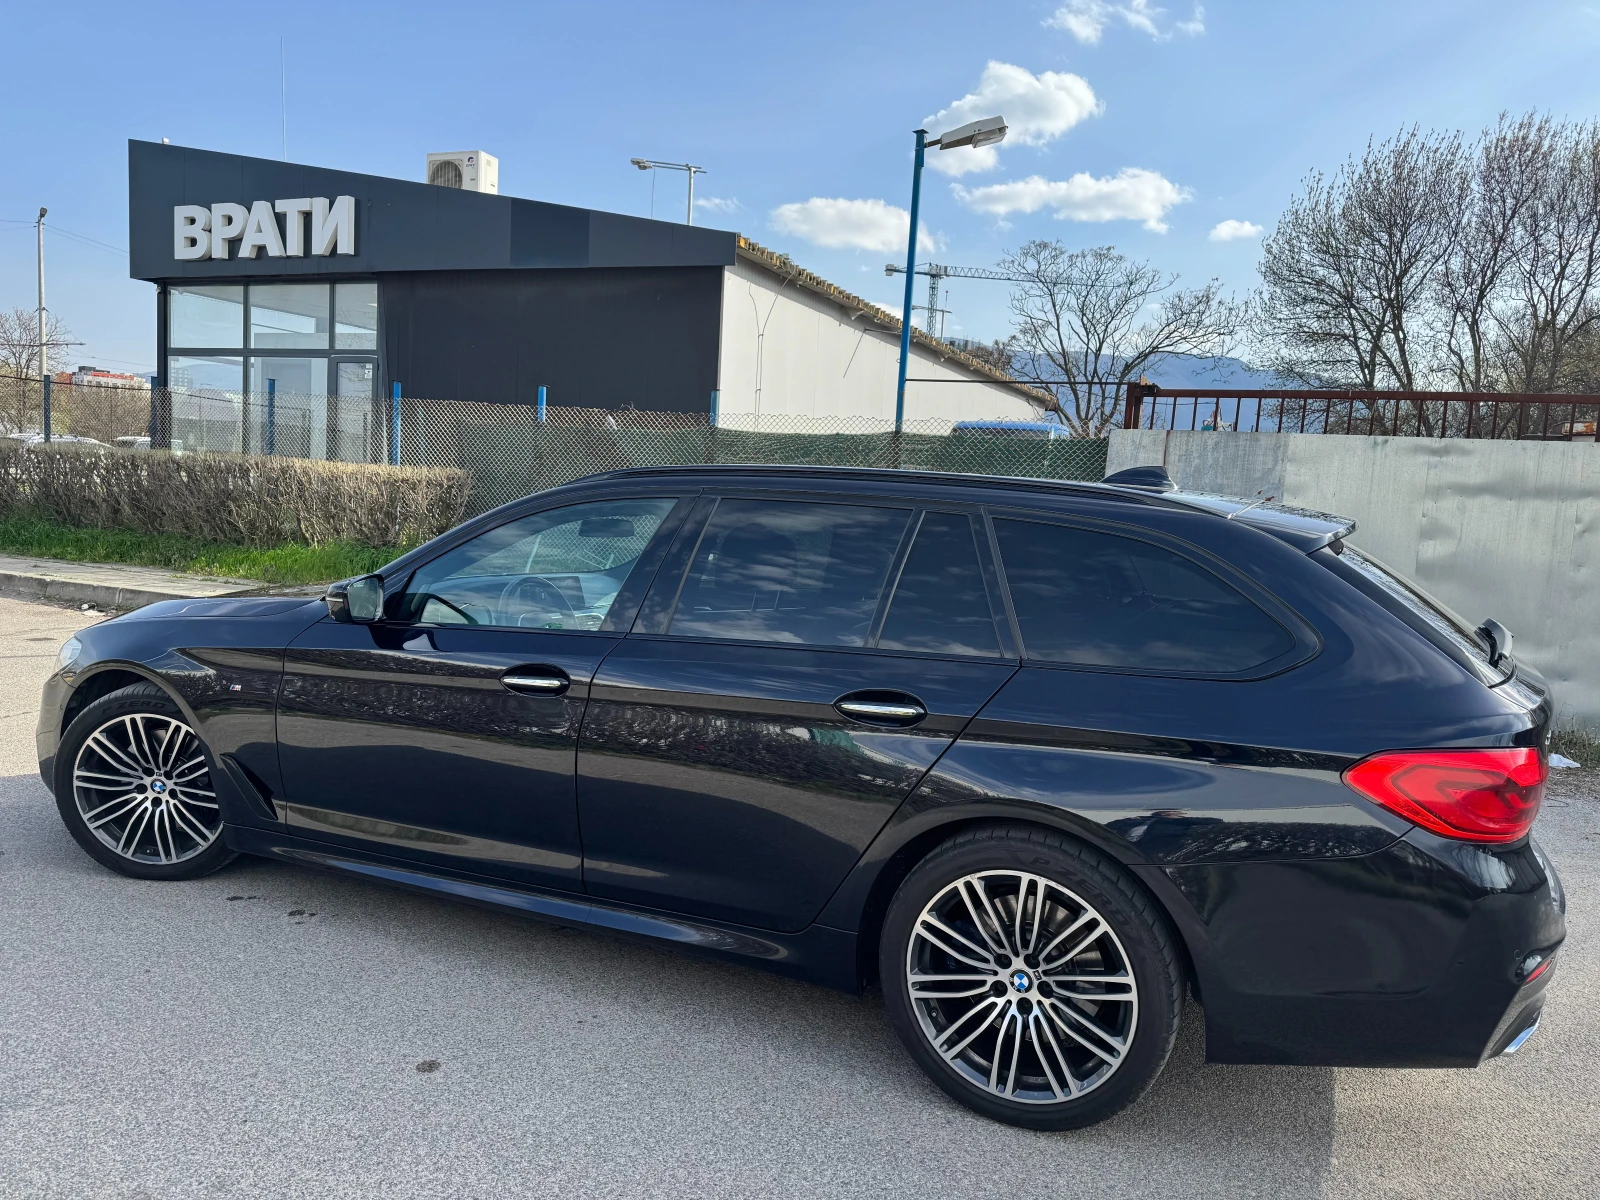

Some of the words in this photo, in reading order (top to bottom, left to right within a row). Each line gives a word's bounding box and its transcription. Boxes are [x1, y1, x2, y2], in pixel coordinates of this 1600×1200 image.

[174, 195, 355, 260] ВРАТИ
[116, 700, 167, 709] ZERO
[1029, 857, 1051, 865] P
[1054, 866, 1131, 926] ZERO
